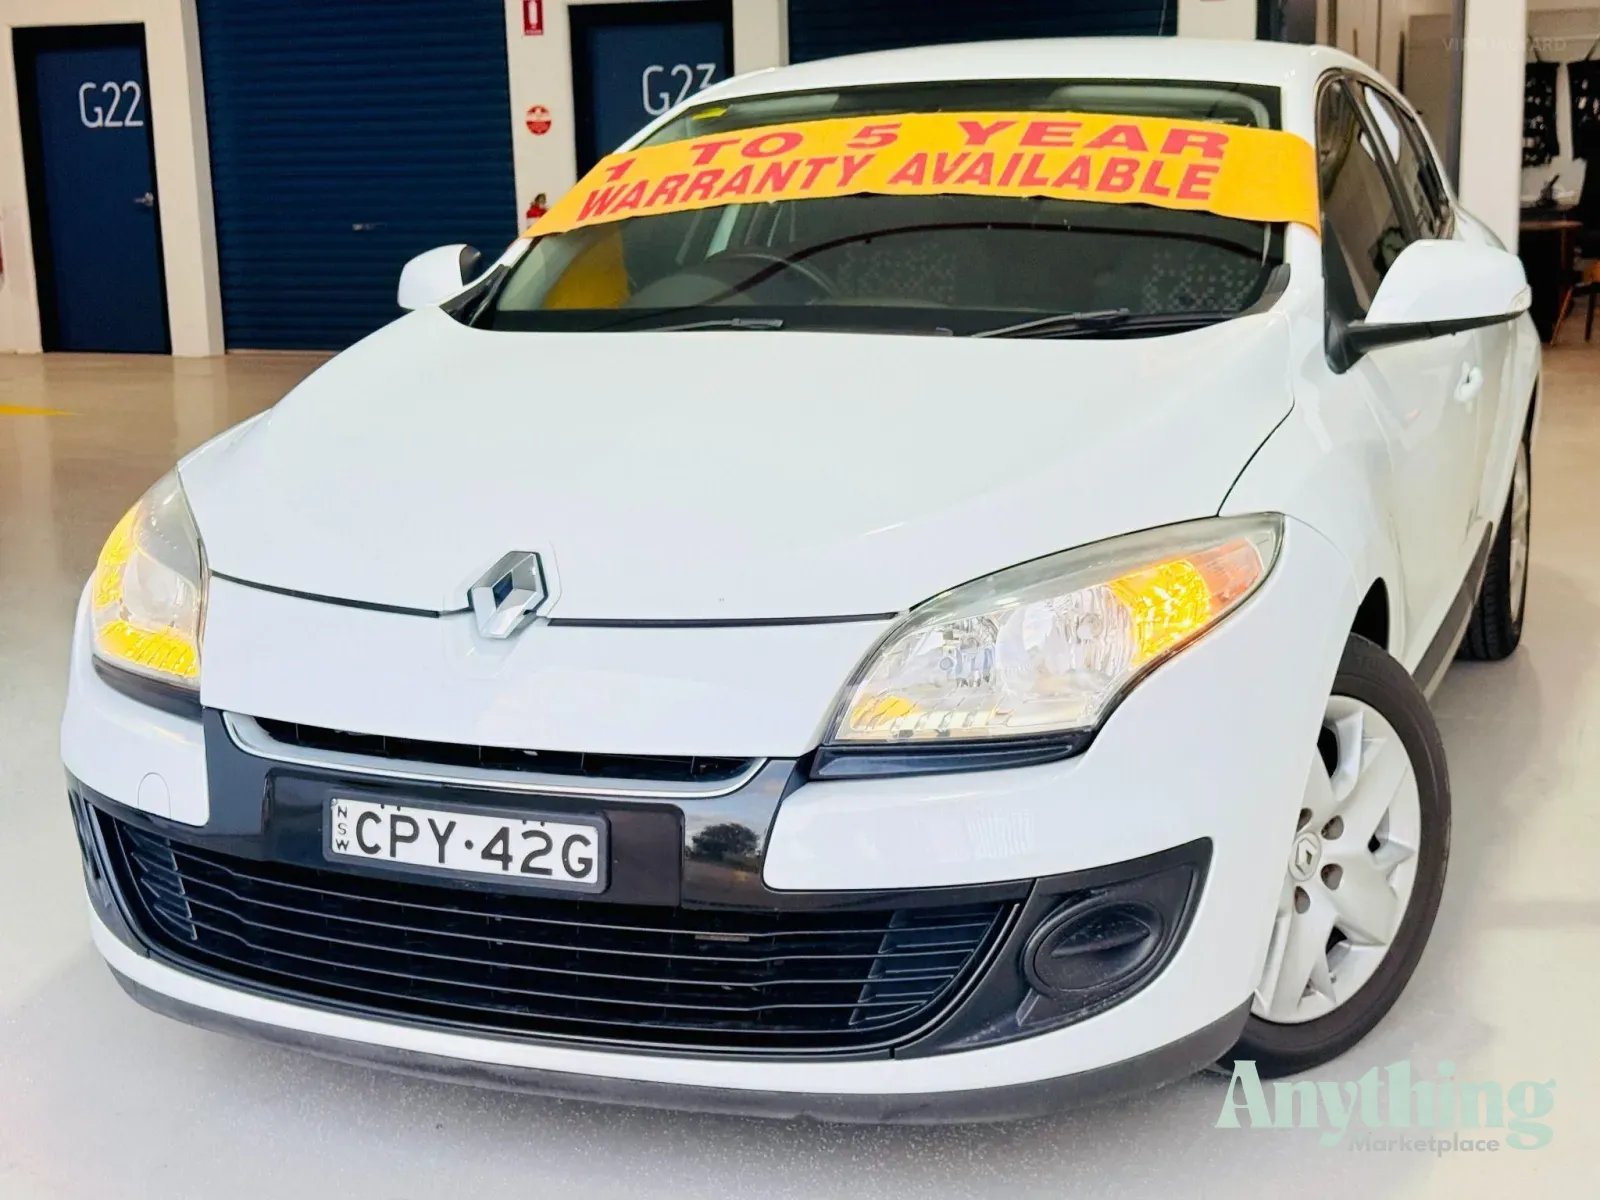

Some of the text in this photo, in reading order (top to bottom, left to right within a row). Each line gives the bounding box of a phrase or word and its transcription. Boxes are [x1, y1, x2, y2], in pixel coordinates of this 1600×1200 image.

[79, 81, 144, 128] G22
[605, 120, 1231, 183] 1 TO 5 YEAR
[575, 151, 1221, 222] WARRANTY AVAILABLE
[336, 806, 350, 851] NSW
